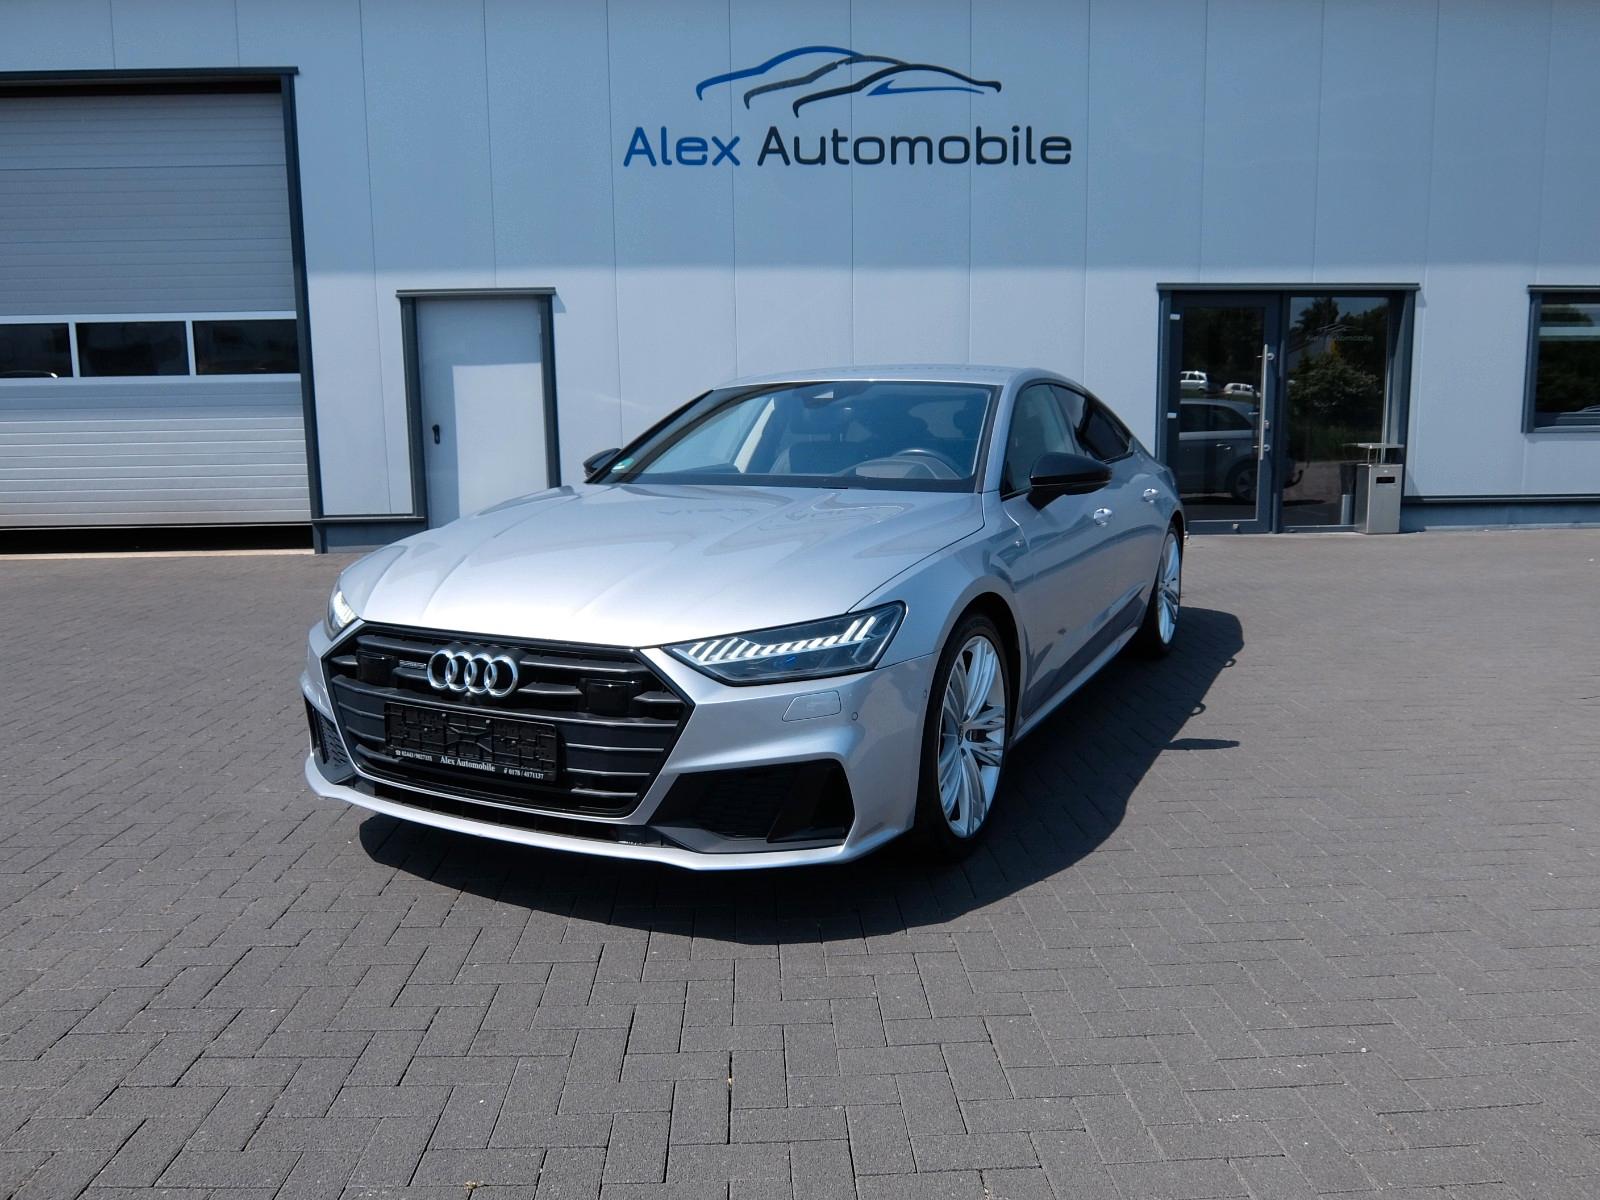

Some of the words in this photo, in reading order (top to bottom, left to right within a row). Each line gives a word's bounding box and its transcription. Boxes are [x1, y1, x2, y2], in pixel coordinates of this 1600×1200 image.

[623, 126, 741, 168] Alex
[757, 126, 1073, 167] Automobile
[440, 755, 455, 766] Alex
[456, 758, 496, 773] Automobile
